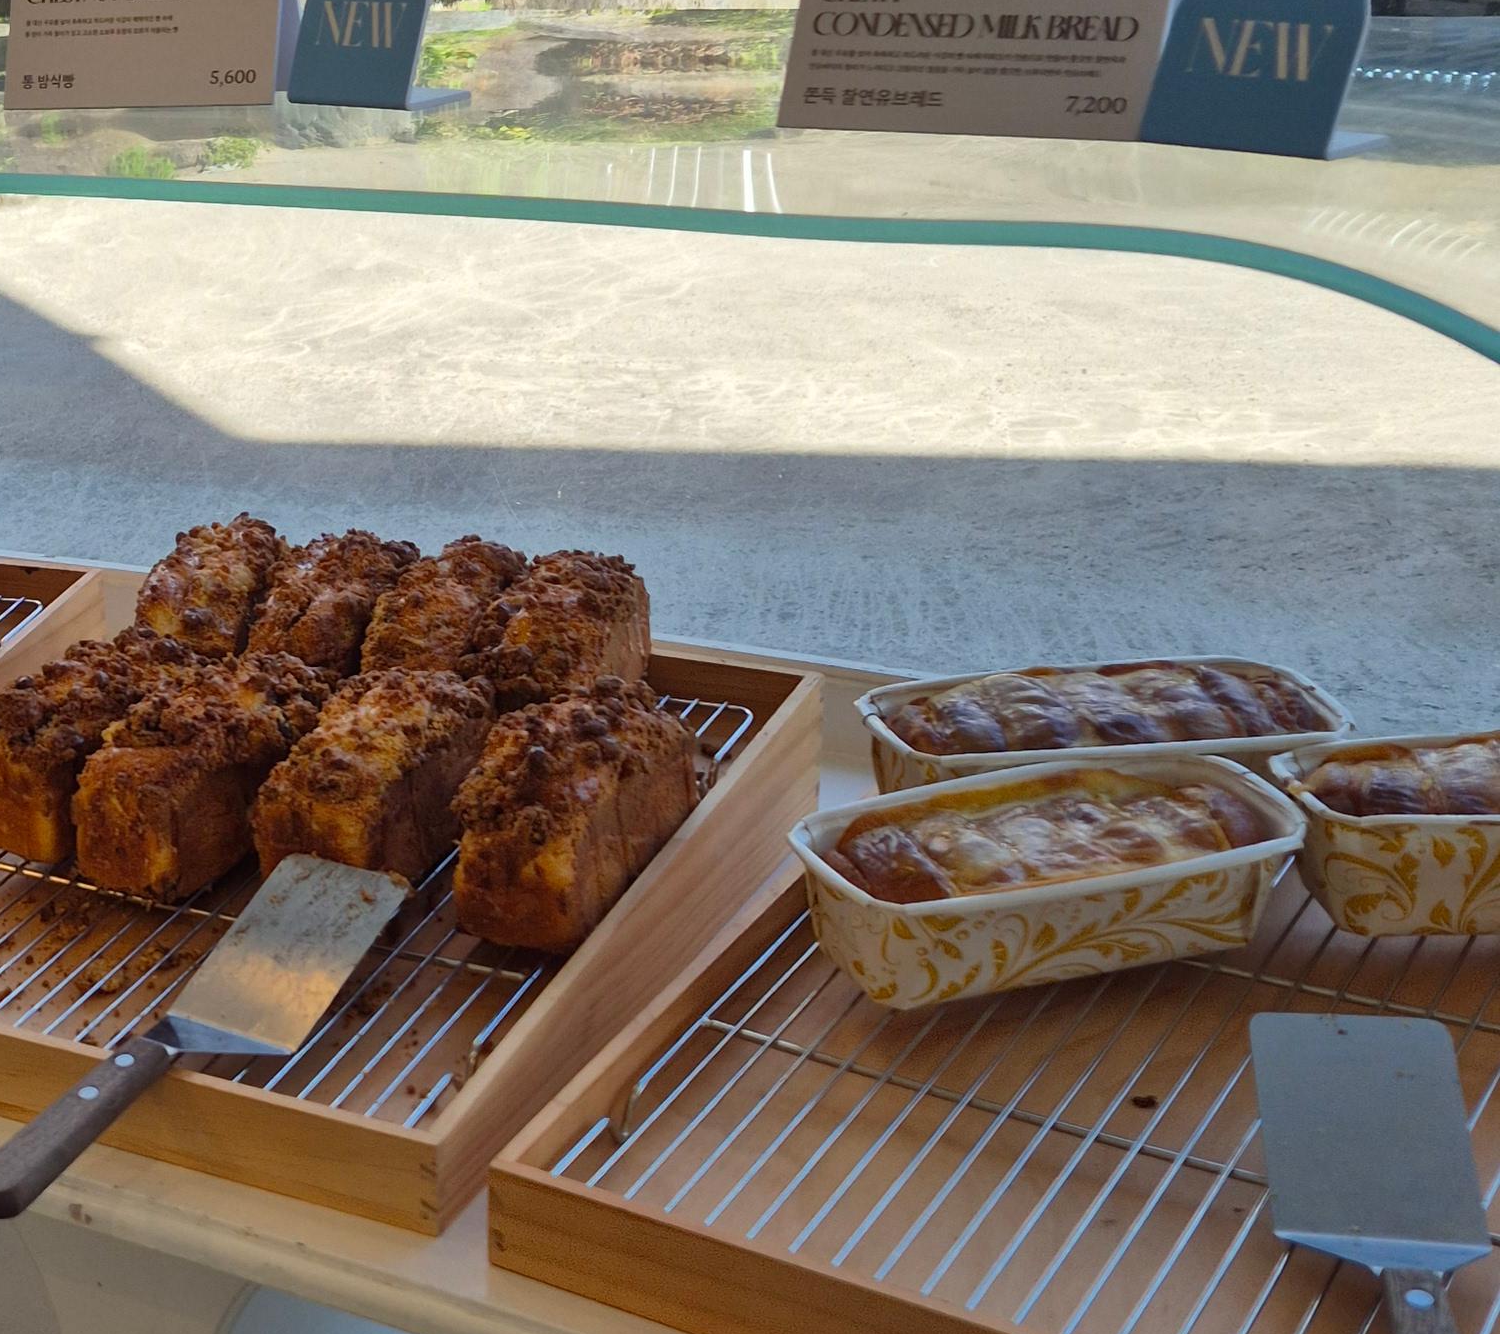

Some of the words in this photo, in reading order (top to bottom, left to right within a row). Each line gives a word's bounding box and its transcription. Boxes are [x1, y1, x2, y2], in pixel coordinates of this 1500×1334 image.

[315, 0, 408, 49] NEW
[813, 11, 975, 39] CONDENSED
[977, 14, 1043, 40] MILK
[1045, 14, 1140, 42] BREAD
[1185, 17, 1334, 81] NEW
[21, 74, 34, 90] 통
[37, 73, 75, 89] 밤식빵
[209, 68, 257, 87] 5,600
[841, 87, 944, 108] 찰연유브레드
[1065, 95, 1128, 115] 7,200
